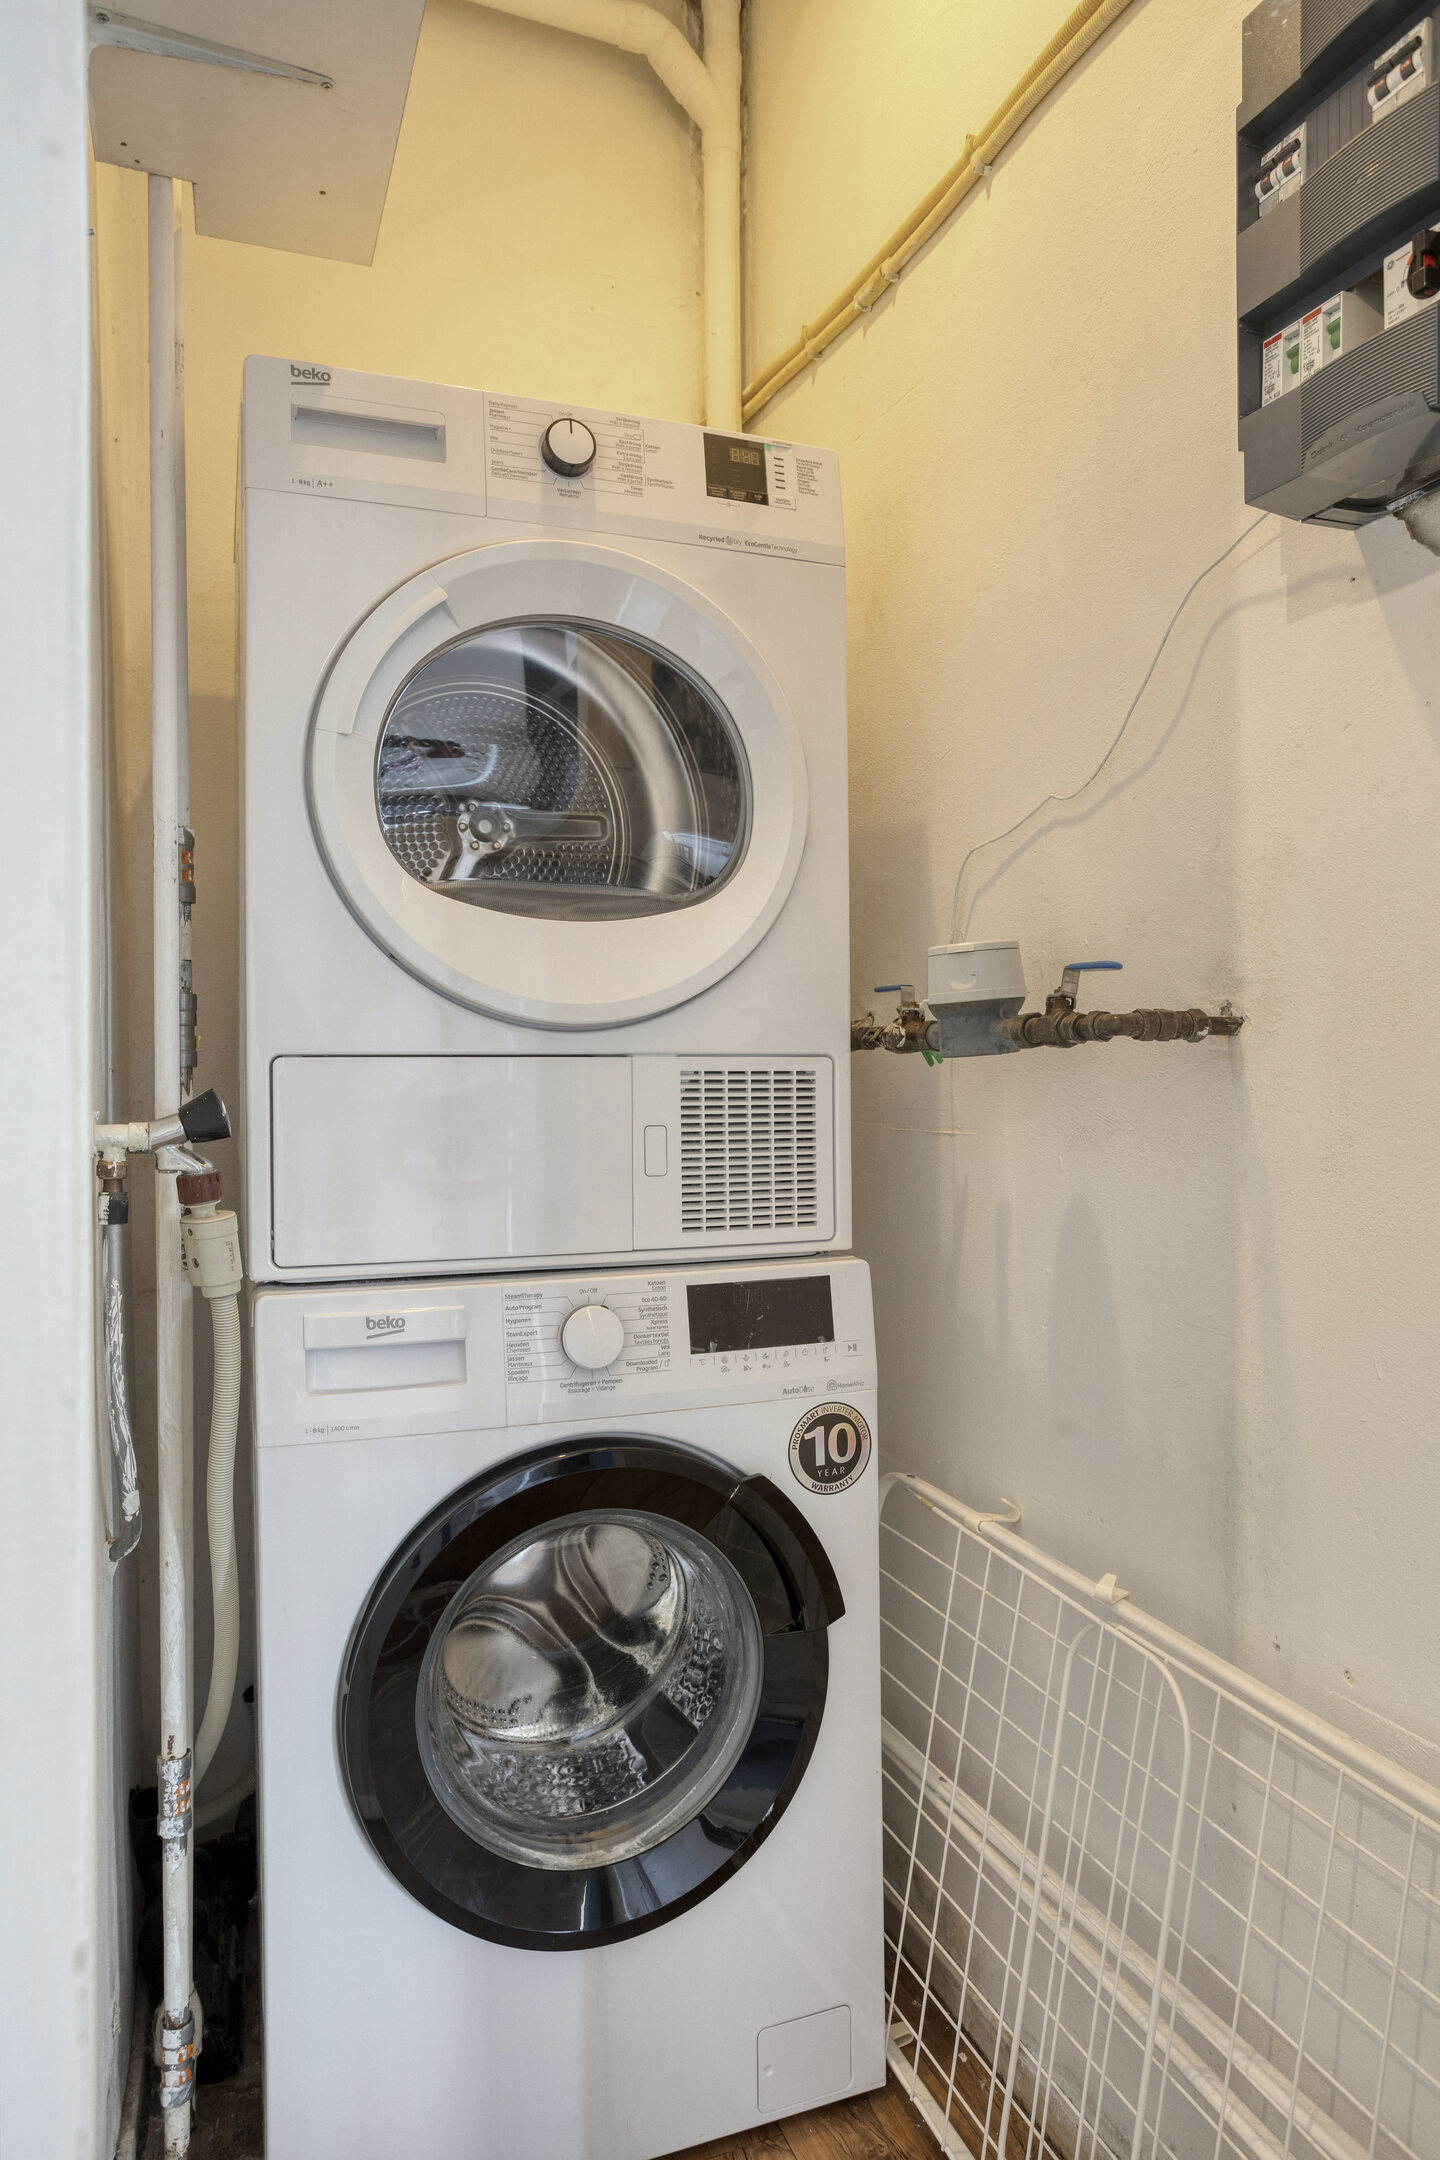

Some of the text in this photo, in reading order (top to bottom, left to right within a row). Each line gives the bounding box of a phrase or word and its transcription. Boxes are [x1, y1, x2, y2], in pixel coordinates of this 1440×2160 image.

[291, 365, 331, 381] beko
[317, 480, 333, 488] A++
[699, 534, 725, 543] Recycled
[366, 1316, 406, 1330] beko
[626, 1359, 658, 1367] Downloaded
[792, 1405, 869, 1450] PROSMART INVERTER MOTOR
[804, 1423, 857, 1467] 10
[817, 1467, 845, 1477] YEAR
[811, 1475, 854, 1492] WARRANTY
